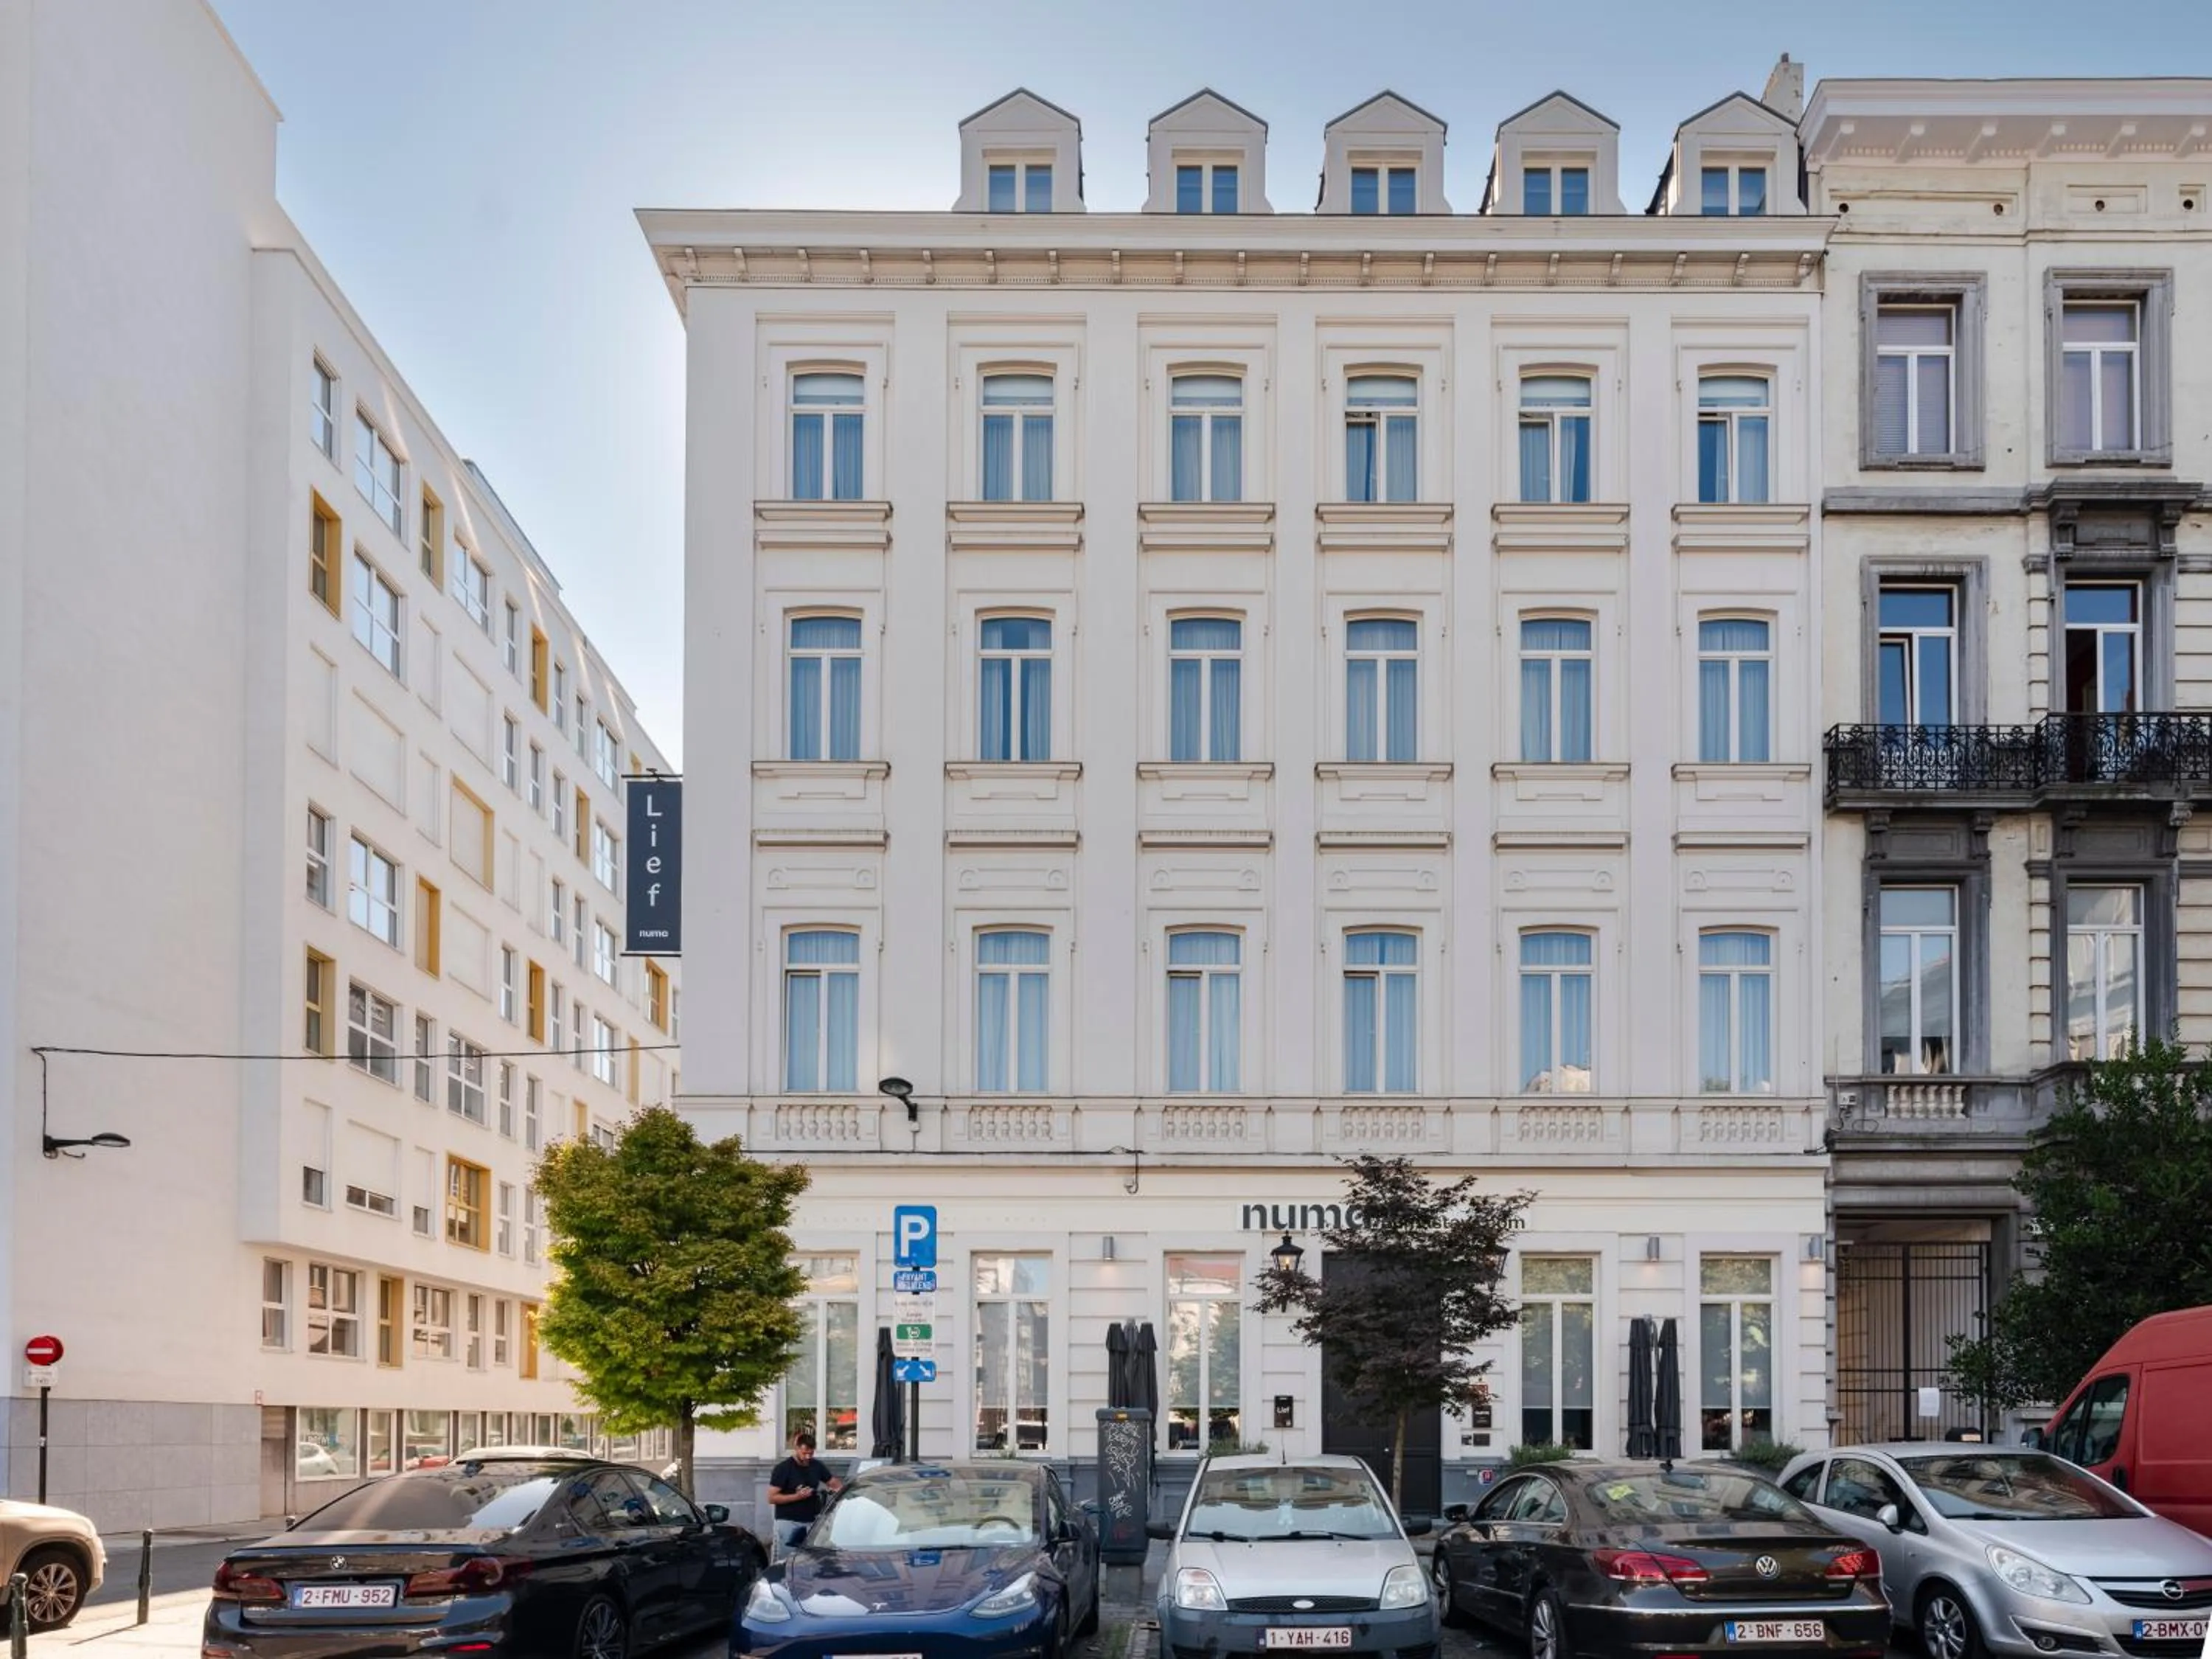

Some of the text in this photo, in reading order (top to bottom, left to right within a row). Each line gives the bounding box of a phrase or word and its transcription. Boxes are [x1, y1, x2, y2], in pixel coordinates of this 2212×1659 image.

[646, 794, 663, 907] Lief
[639, 929, 669, 937] numa
[1242, 1204, 1370, 1230] numa
[900, 1214, 930, 1258] P
[1270, 1630, 1349, 1645] 1-YAH-416
[2143, 1622, 2208, 1638] 2-BMX-0
